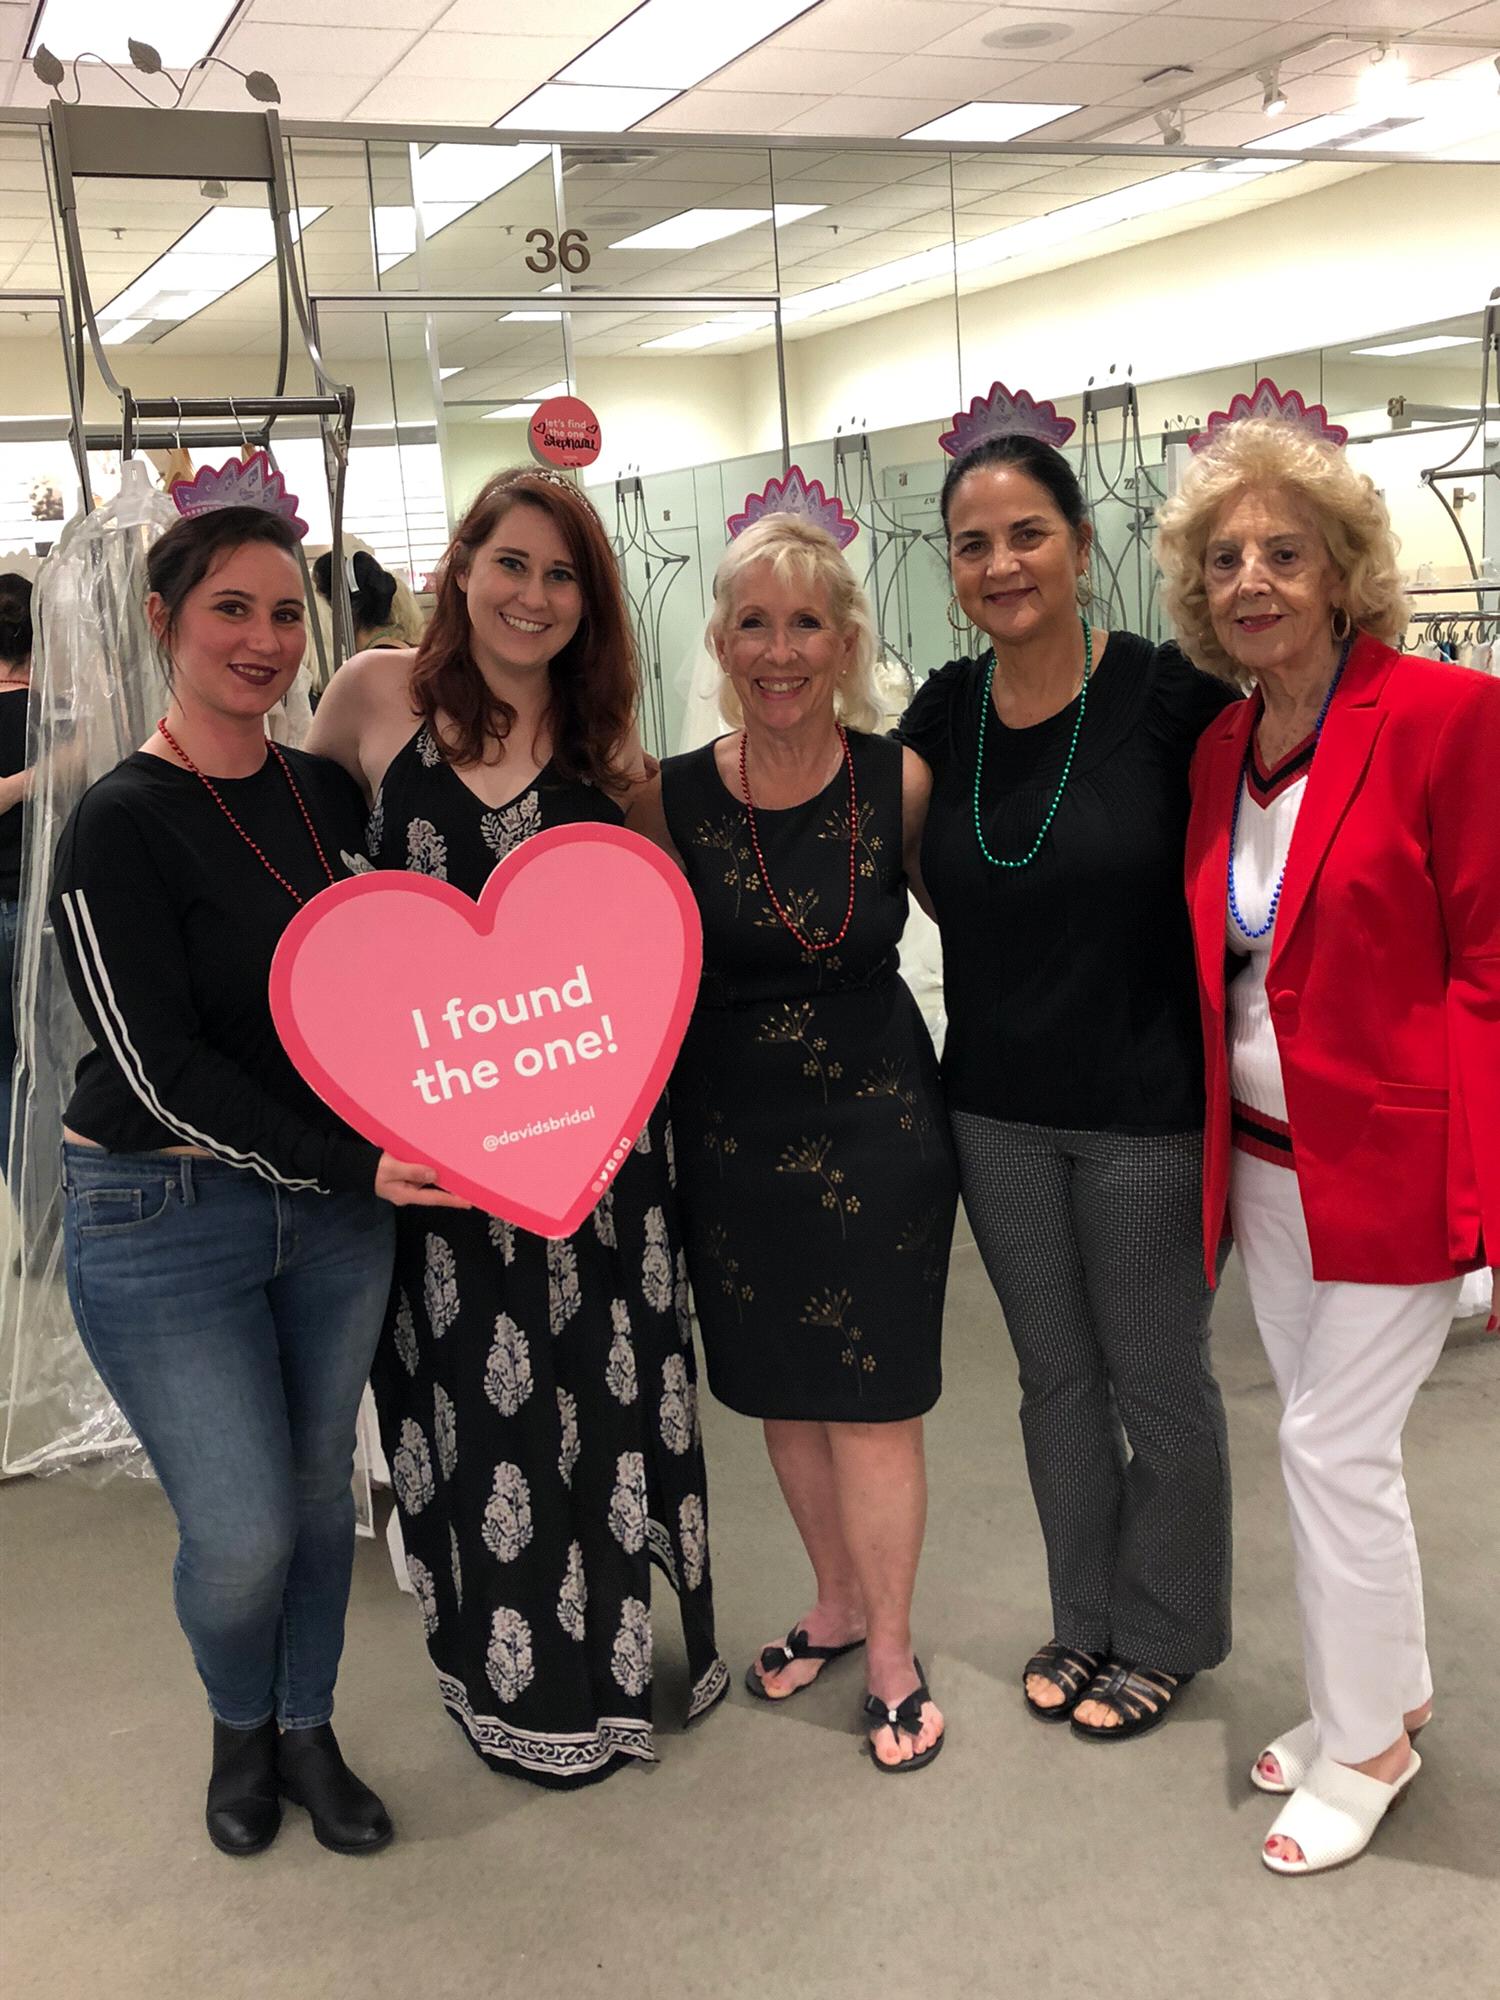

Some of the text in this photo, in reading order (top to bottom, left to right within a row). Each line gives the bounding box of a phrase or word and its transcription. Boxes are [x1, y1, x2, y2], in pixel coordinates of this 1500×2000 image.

[525, 228, 591, 274] 36
[545, 418, 587, 429] let's find
[549, 428, 585, 439] the one
[411, 964, 593, 1049] I found
[411, 1014, 618, 1104] the one!
[482, 1105, 596, 1152] @davidsbridal
